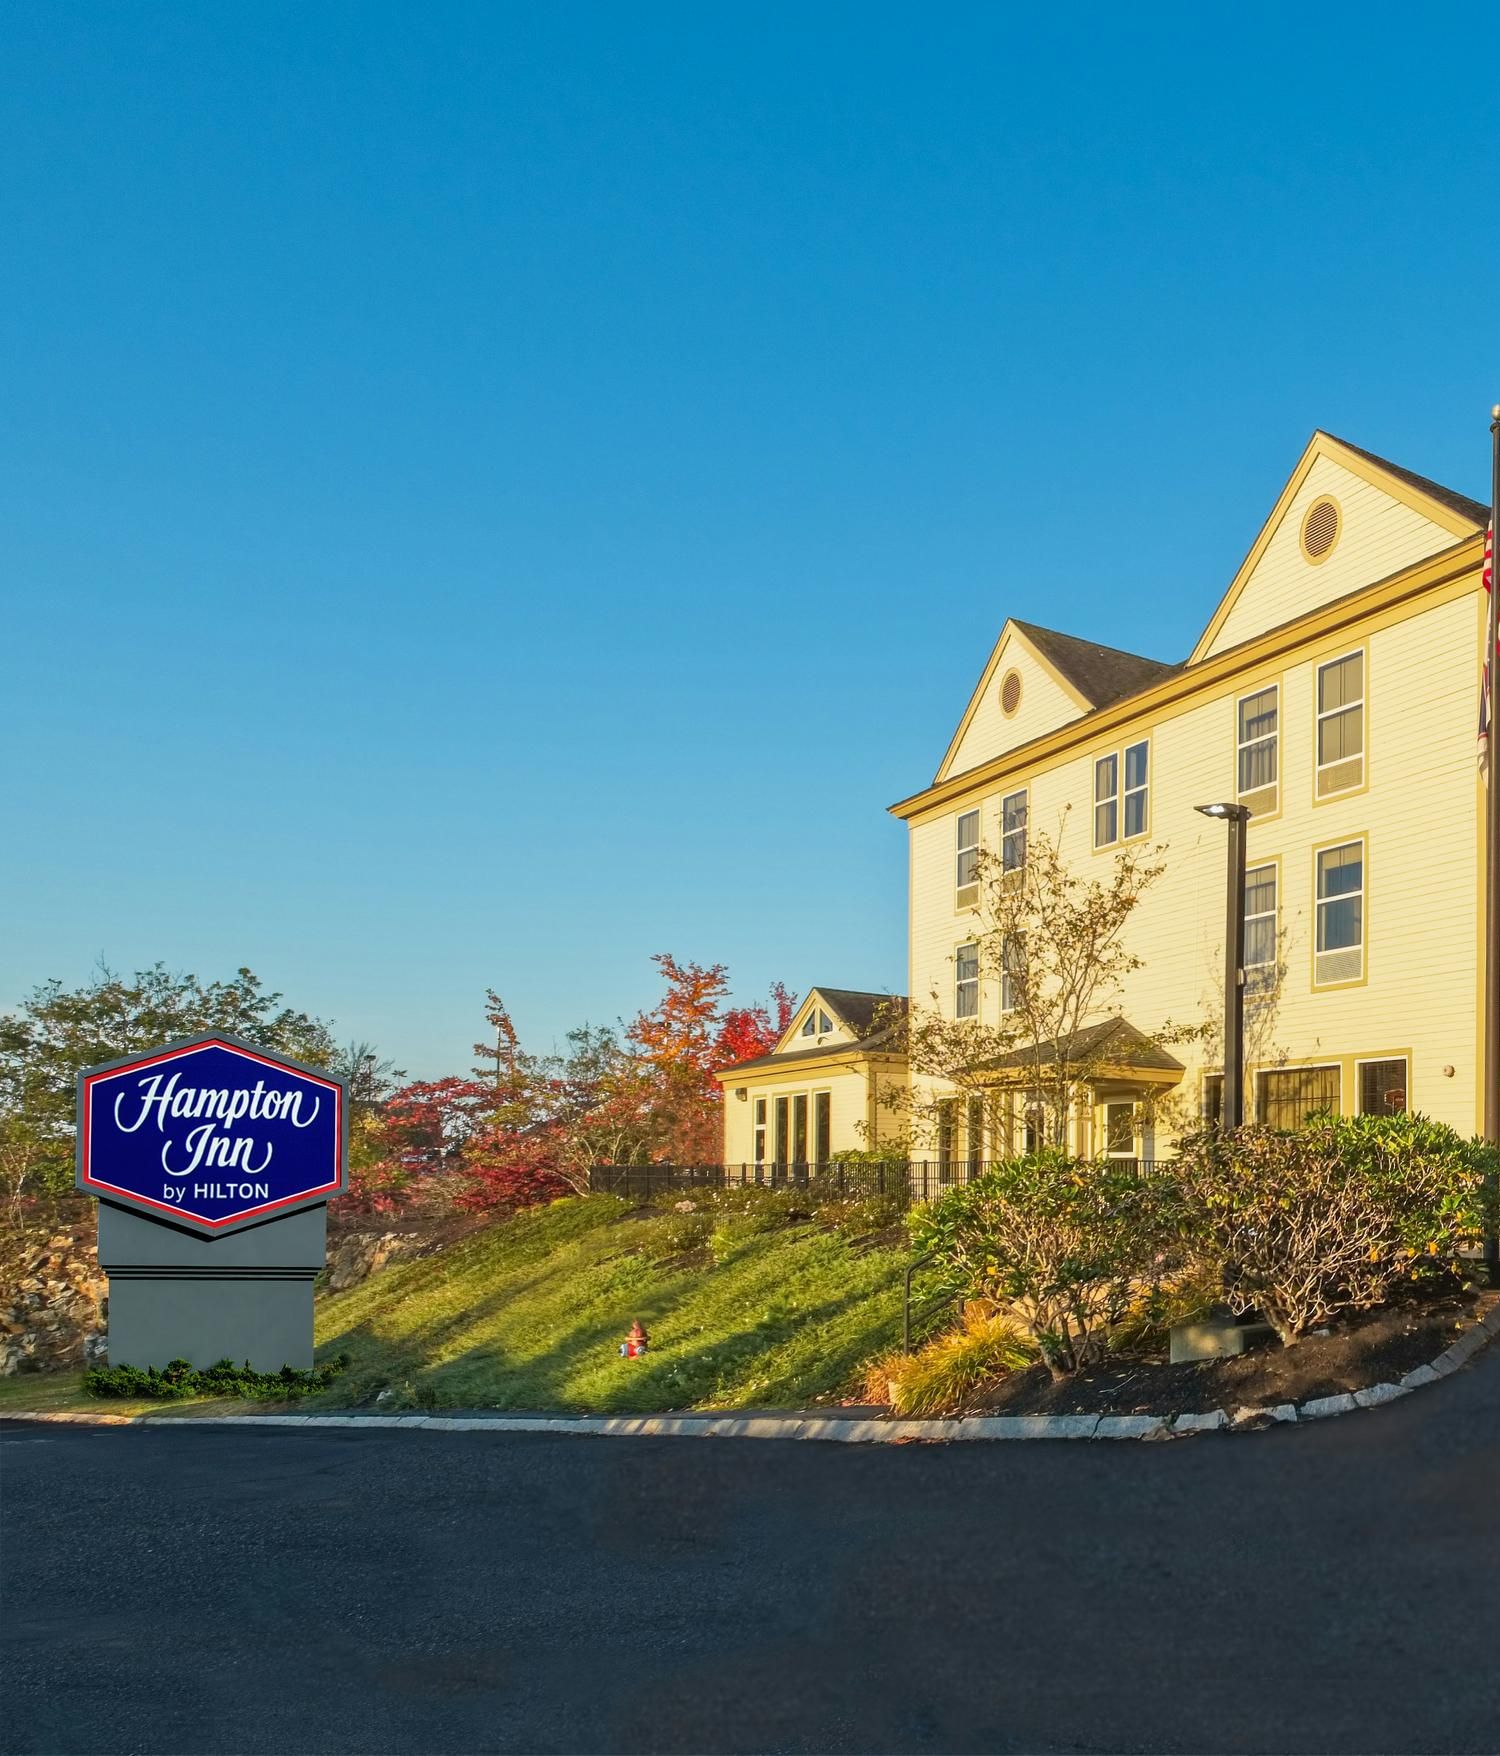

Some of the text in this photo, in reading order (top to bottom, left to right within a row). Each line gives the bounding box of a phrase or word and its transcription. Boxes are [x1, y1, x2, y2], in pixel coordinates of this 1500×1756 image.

[114, 1072, 320, 1132] Hampton
[161, 1123, 273, 1176] Inn
[163, 1183, 269, 1203] by HILTON
